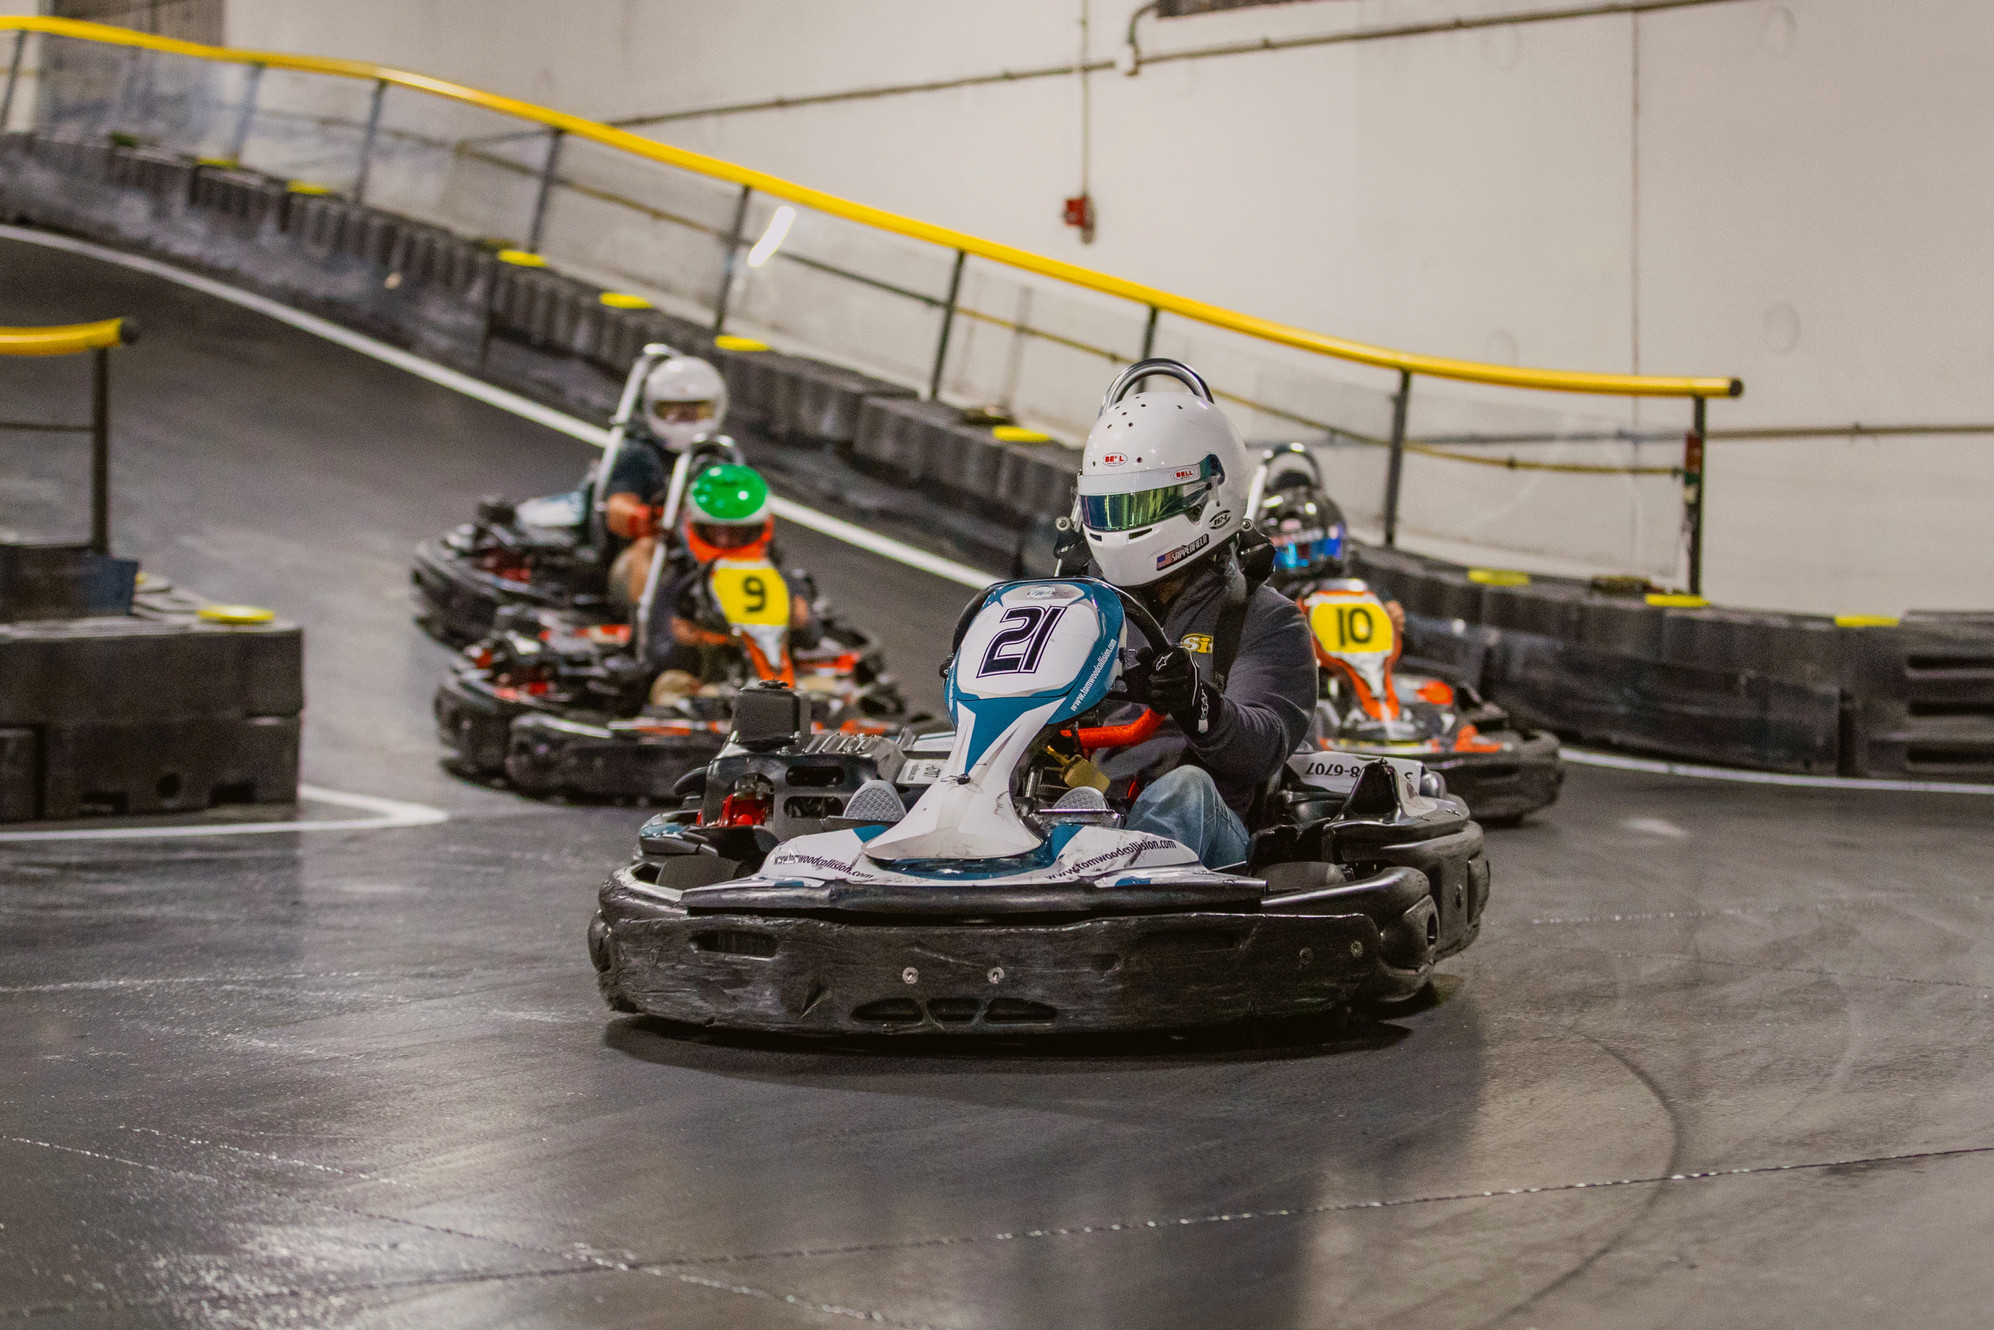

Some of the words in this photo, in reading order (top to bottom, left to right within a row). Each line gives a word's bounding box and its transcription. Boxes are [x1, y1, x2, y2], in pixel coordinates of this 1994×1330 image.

[1176, 470, 1194, 478] BELL
[743, 576, 767, 614] 9
[976, 605, 1068, 679] 21
[1336, 607, 1374, 647] 10
[1070, 638, 1118, 712] www.tomwoodcollision.com
